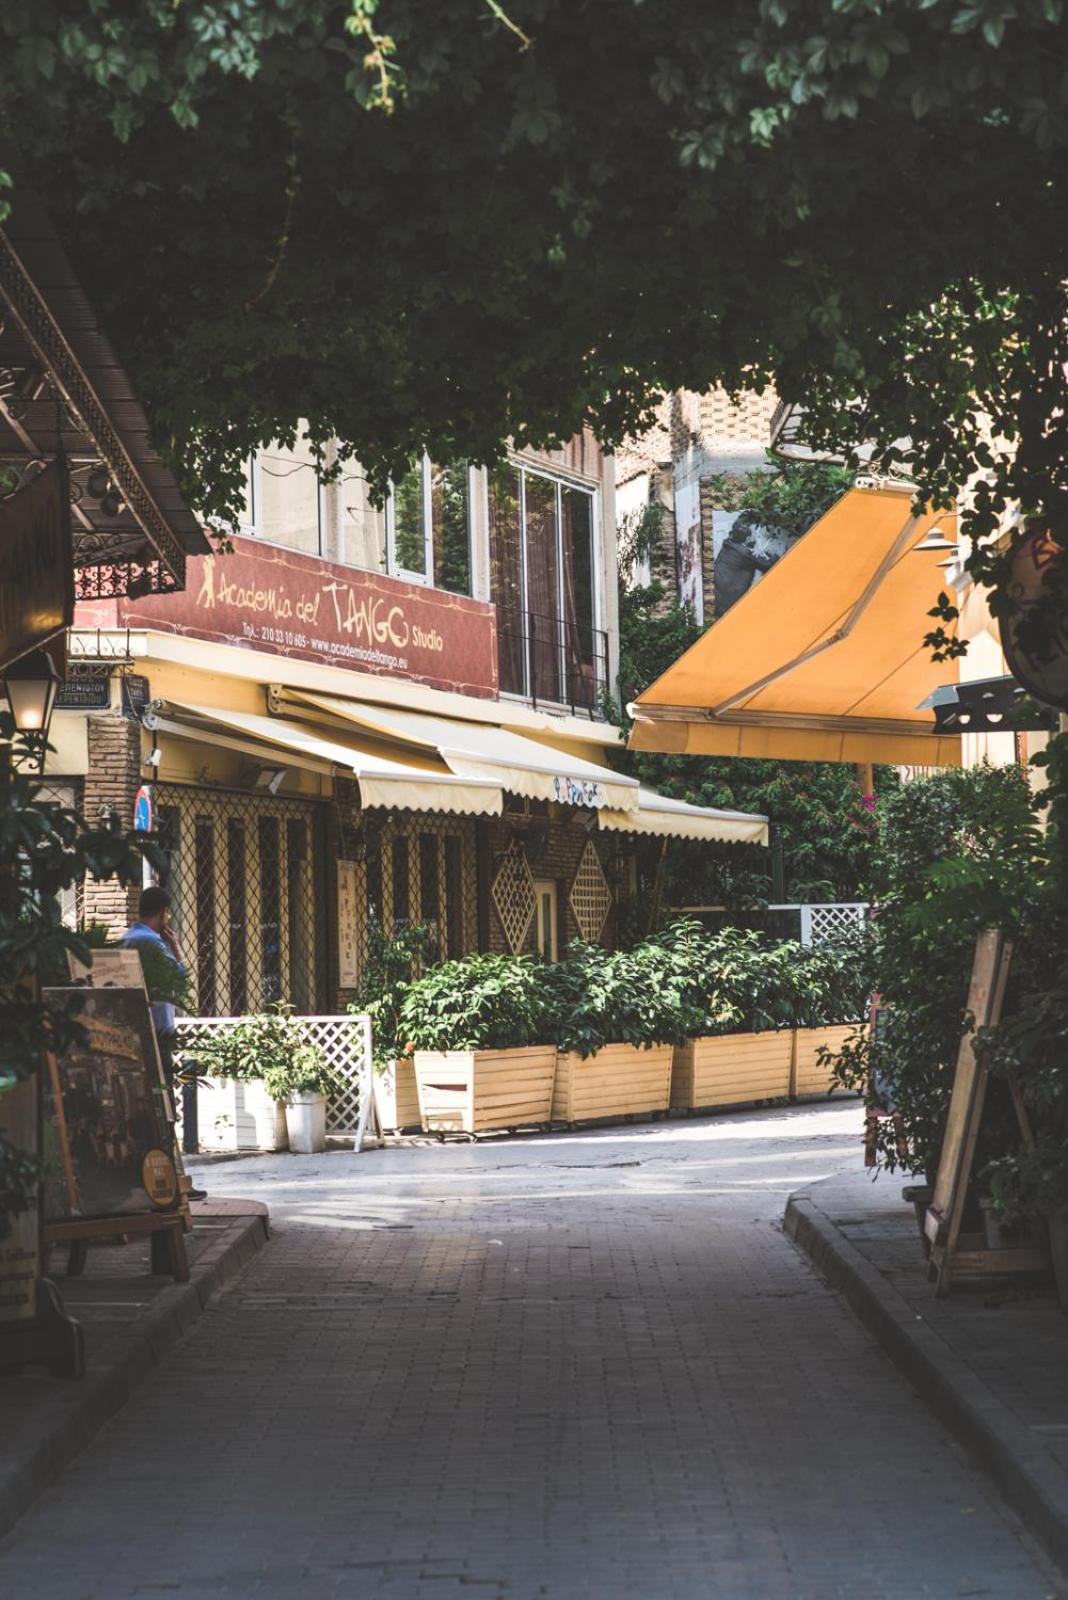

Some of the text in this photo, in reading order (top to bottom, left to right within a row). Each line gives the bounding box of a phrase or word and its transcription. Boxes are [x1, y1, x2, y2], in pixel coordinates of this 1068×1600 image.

[261, 626, 274, 642] 210
[275, 630, 284, 644] 33
[285, 632, 294, 646] 10
[296, 593, 320, 626] del
[322, 581, 409, 648] TANGO
[412, 625, 443, 652] Studio
